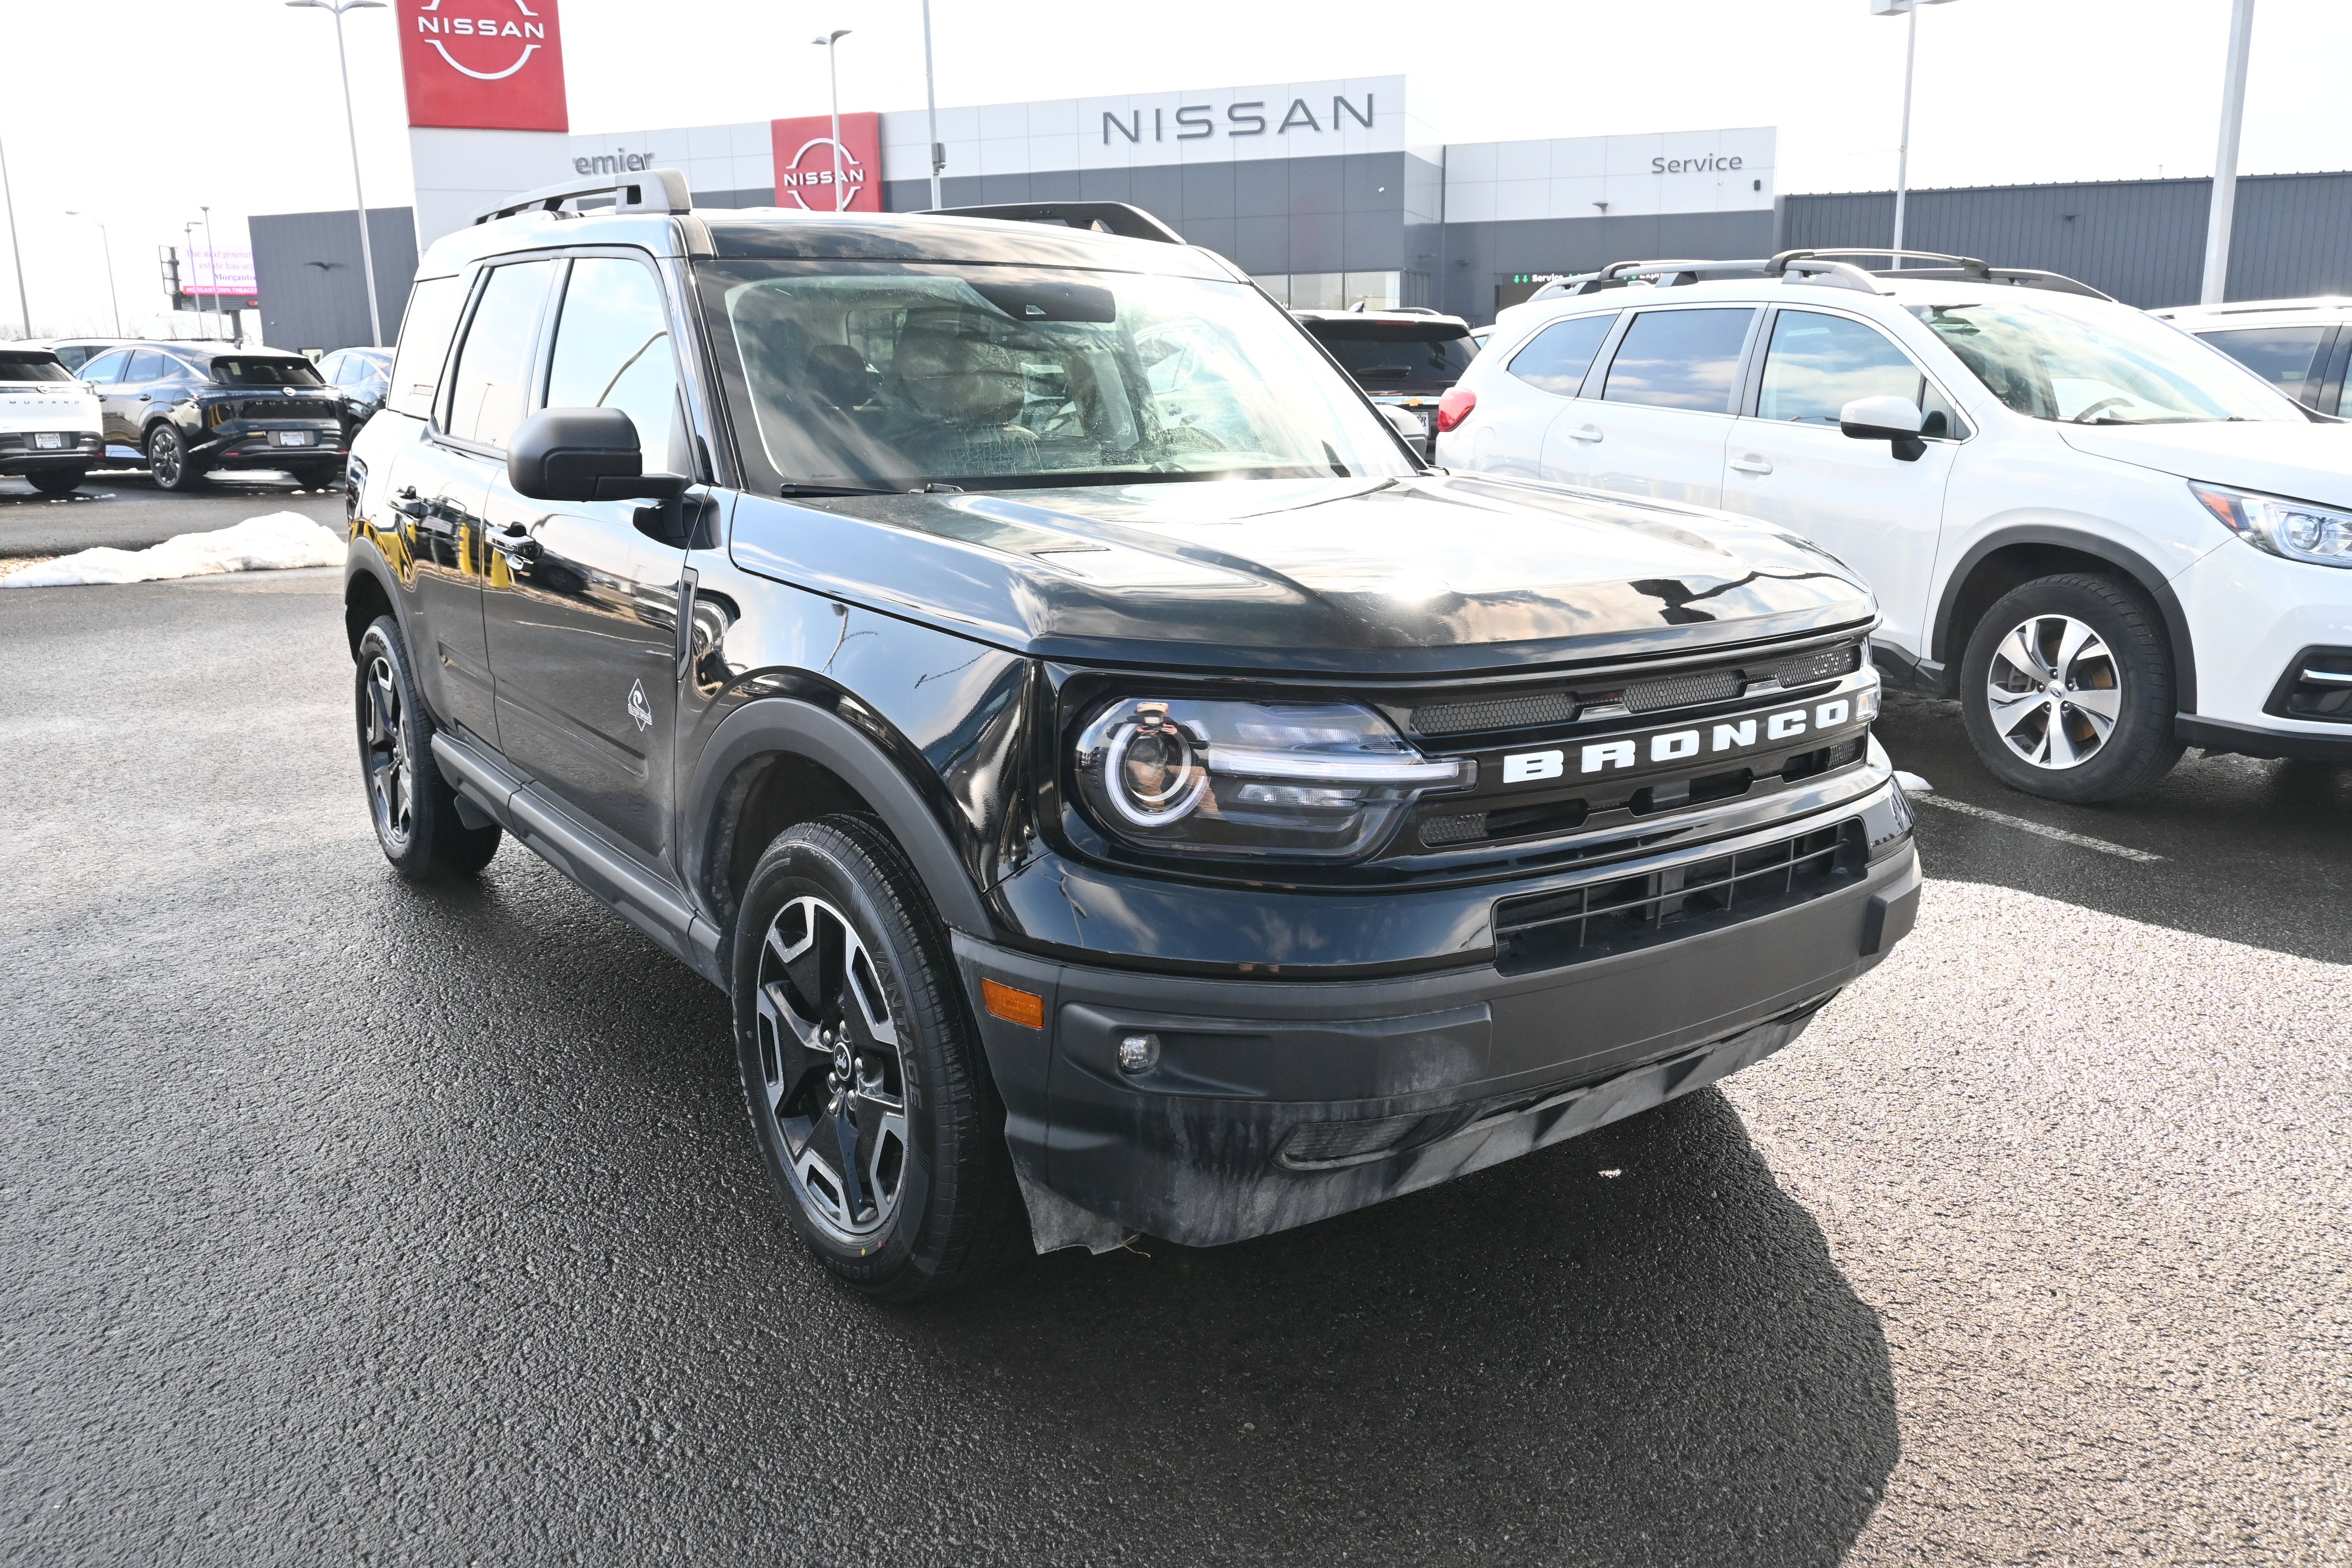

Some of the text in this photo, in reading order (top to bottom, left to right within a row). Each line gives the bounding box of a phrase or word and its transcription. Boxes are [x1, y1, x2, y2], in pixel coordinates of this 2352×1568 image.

[418, 16, 544, 38] NISSAN
[1102, 93, 1374, 144] NISSAN
[572, 147, 654, 175] emier
[1652, 153, 1742, 173] Service
[784, 169, 864, 186] NISSAN
[226, 261, 240, 270] has
[1532, 273, 1563, 282] Service
[1503, 699, 1849, 784] BRONCO
